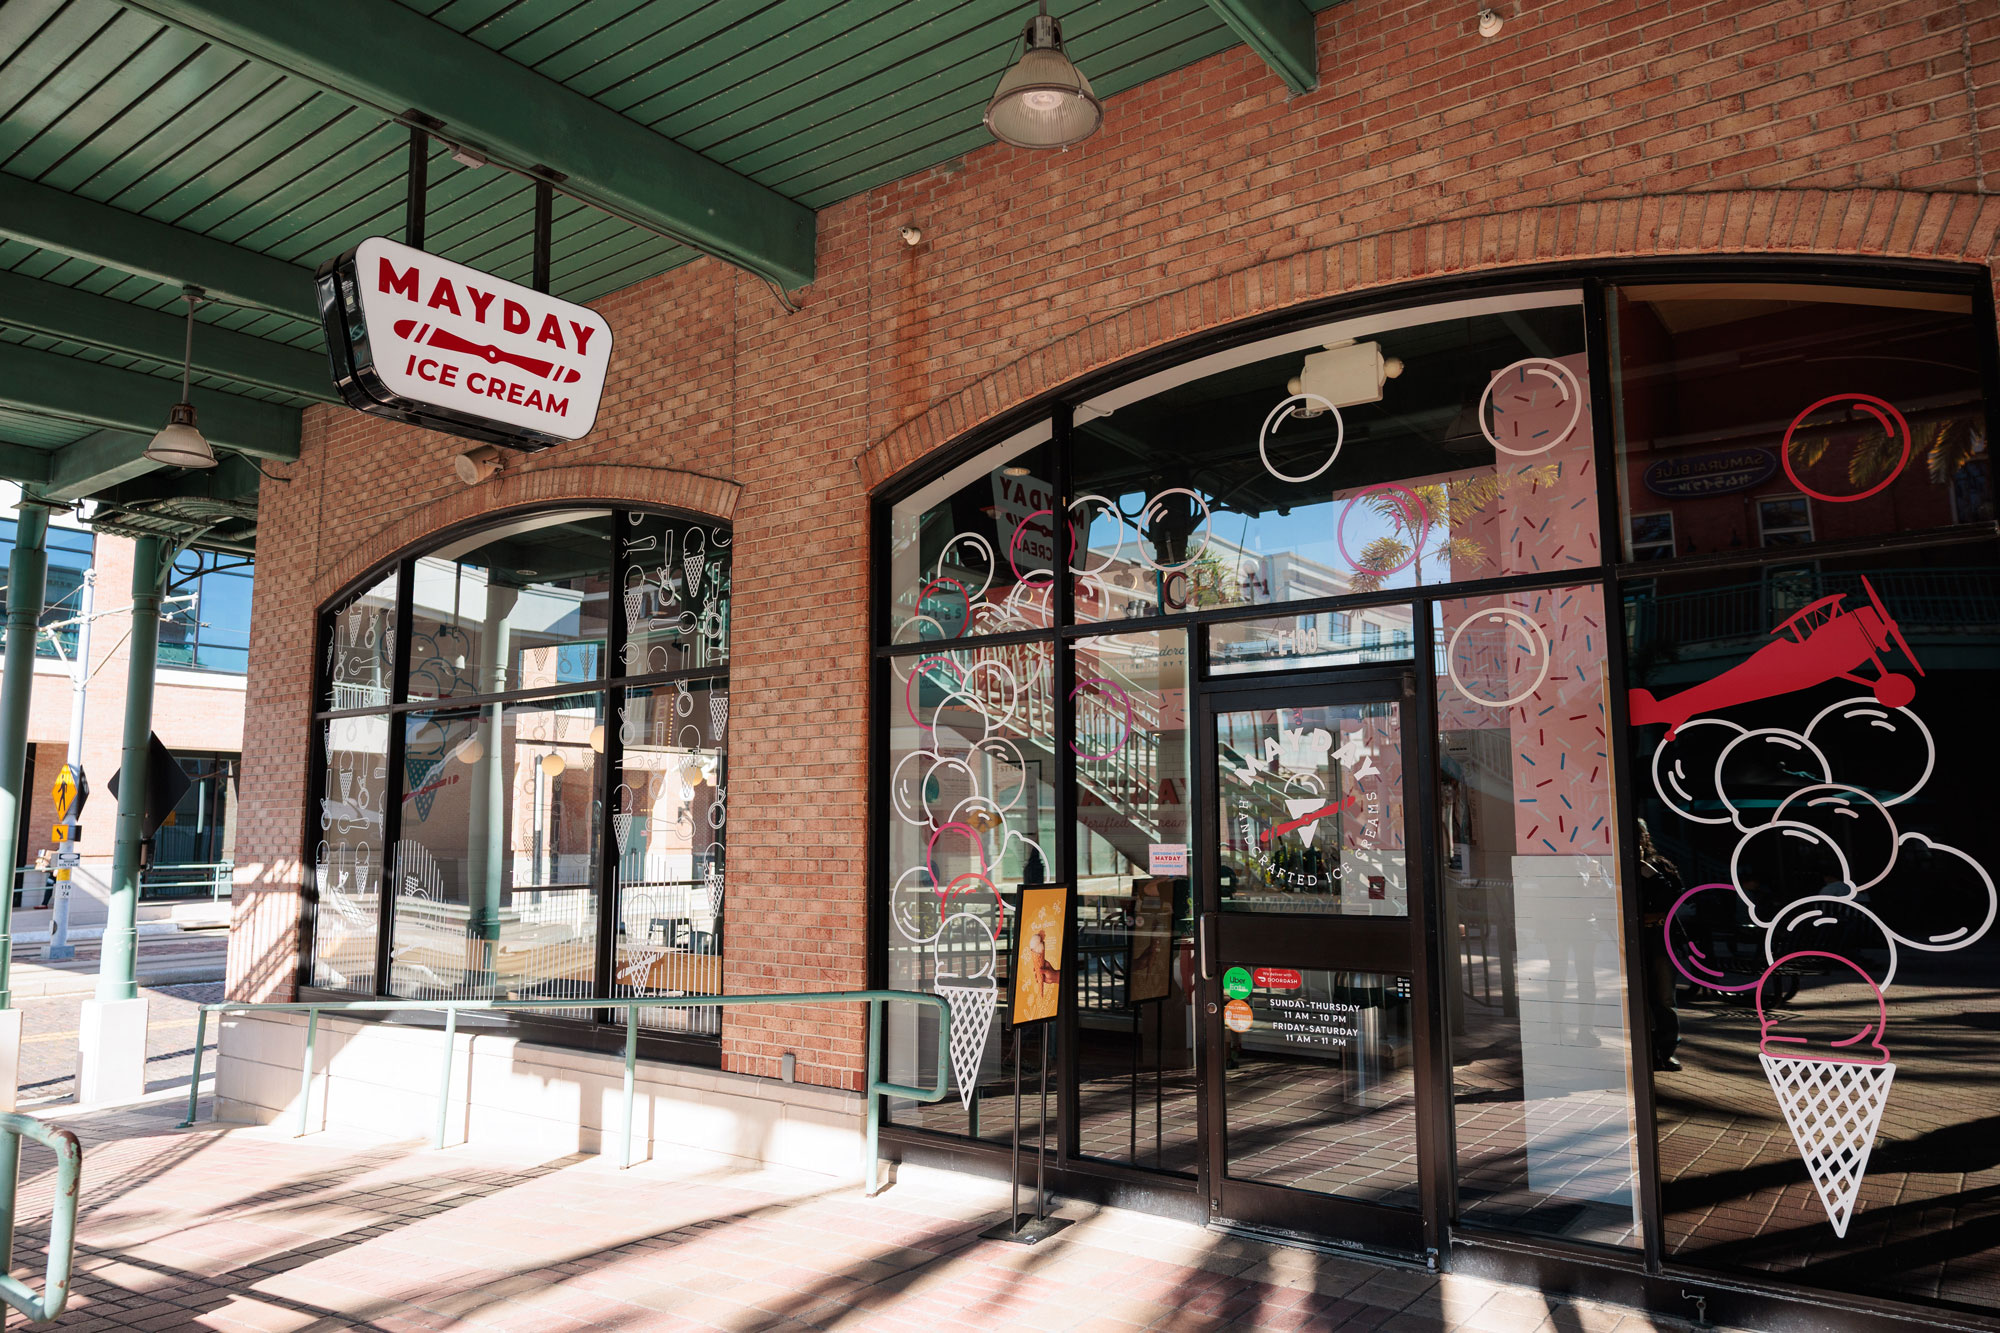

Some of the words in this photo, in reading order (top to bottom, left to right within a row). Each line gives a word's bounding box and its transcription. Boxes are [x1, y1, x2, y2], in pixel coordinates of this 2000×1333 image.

[378, 256, 596, 357] MAYDAY
[405, 354, 460, 388] ICE
[466, 372, 570, 417] CREAM
[1278, 628, 1317, 655] E100
[1234, 727, 1381, 787] MAYDAY
[1238, 799, 1318, 886] HANDCRAFTED
[1325, 862, 1353, 884] ICE
[1355, 791, 1379, 860] CREAMS
[1229, 976, 1246, 984] Uber
[1270, 998, 1360, 1013] SUNDAY-THURSDAY
[1284, 1011, 1292, 1019] 11
[1294, 1012, 1310, 1020] AM
[1319, 1013, 1330, 1021] 10
[1332, 1014, 1347, 1023] PM
[1272, 1022, 1358, 1037] FRIDAY-SATURDAY
[1285, 1034, 1294, 1042] 11
[1296, 1035, 1311, 1043] AM
[1321, 1037, 1329, 1045] 11
[1332, 1038, 1347, 1046] PM
